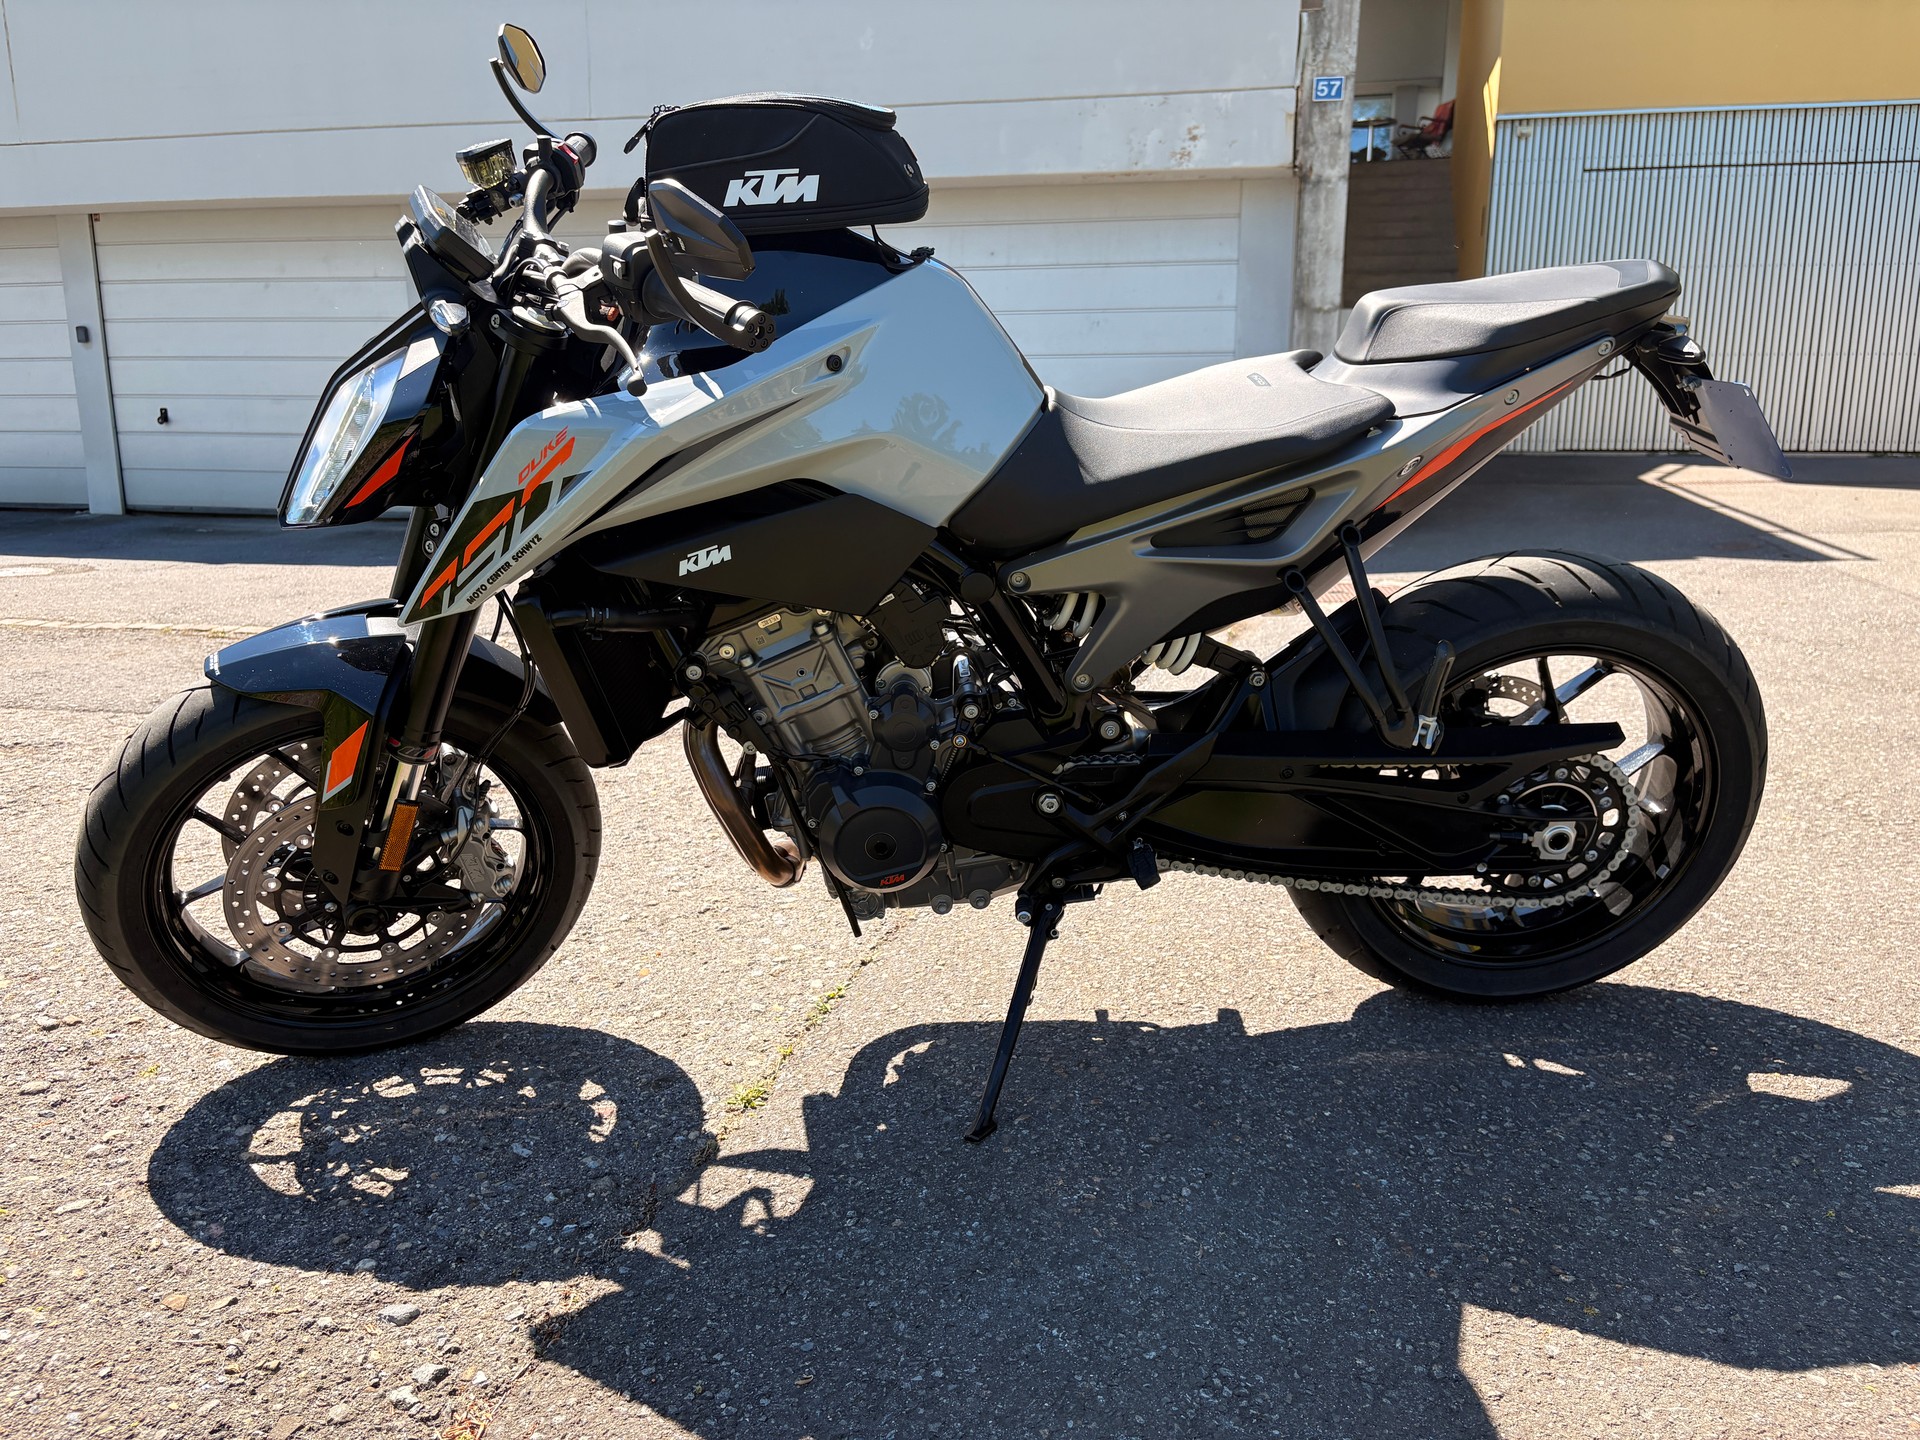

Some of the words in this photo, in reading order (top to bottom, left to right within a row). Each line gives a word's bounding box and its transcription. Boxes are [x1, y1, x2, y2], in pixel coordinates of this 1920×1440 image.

[1316, 81, 1342, 97] 57
[723, 168, 820, 207] KTM
[518, 426, 569, 486] DUKE
[466, 584, 488, 605] MOTO
[487, 561, 513, 585] CENTER
[511, 534, 543, 563] SCHWYZ
[679, 545, 732, 576] KTM
[880, 874, 905, 886] KTM
